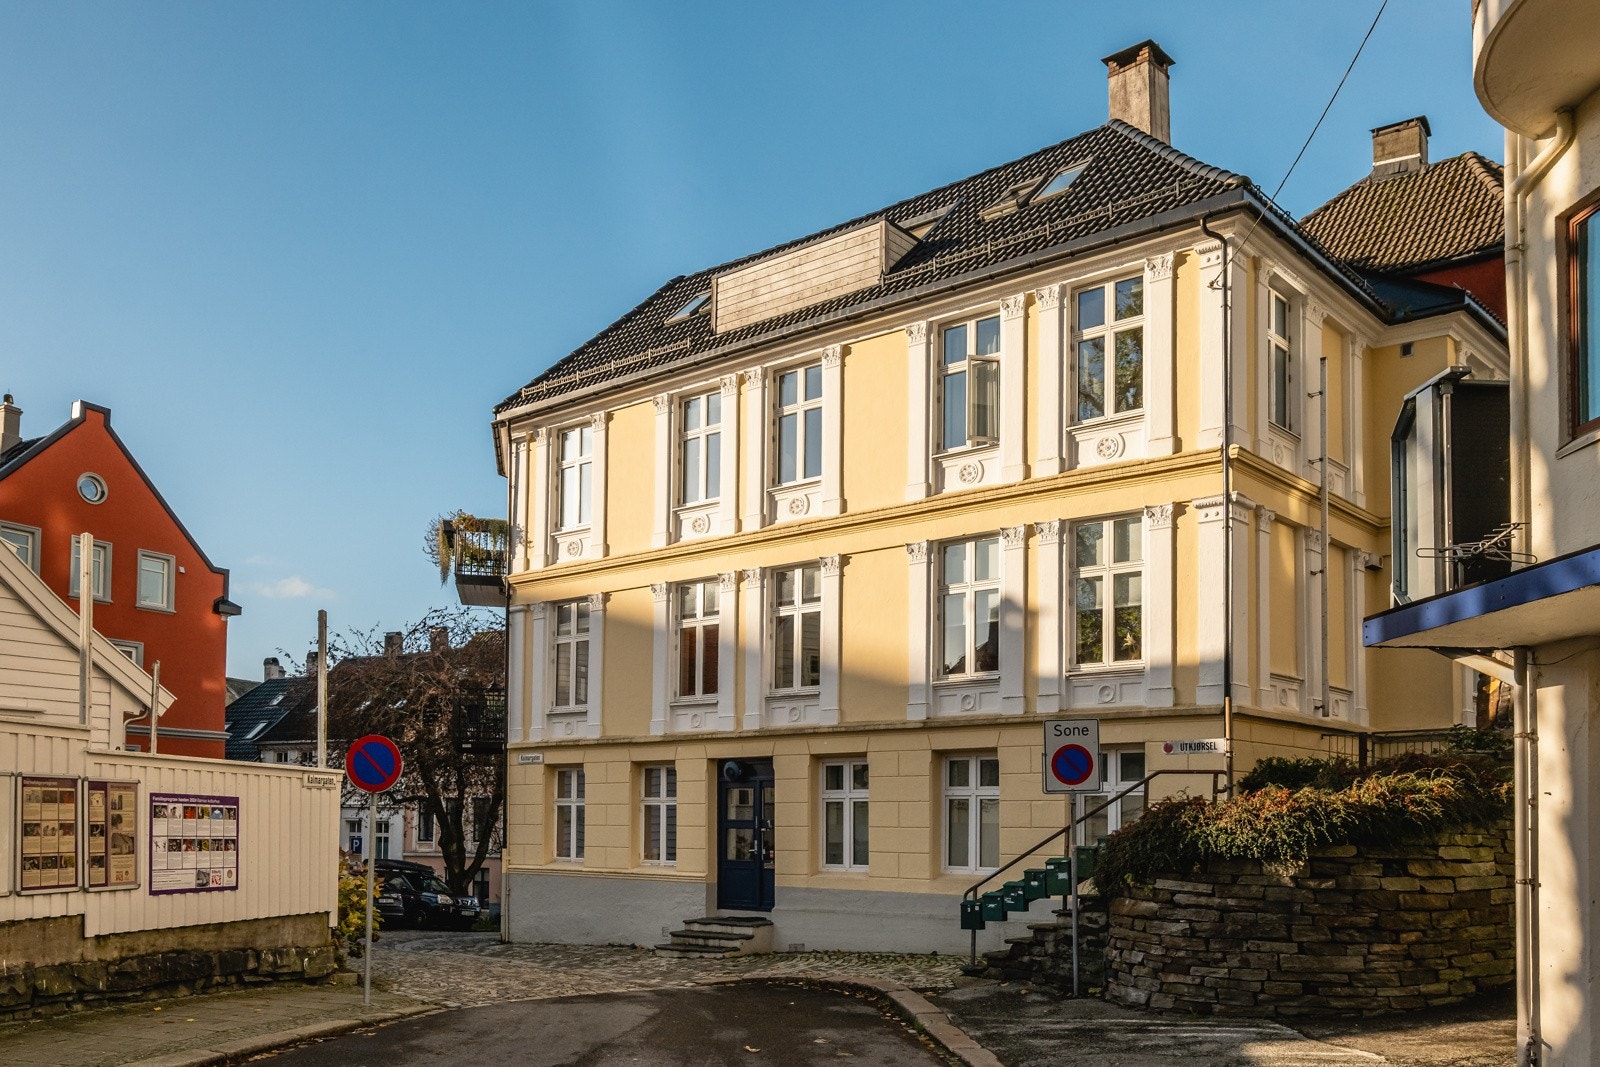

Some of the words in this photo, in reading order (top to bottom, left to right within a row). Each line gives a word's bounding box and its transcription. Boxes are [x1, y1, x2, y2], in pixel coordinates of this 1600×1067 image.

[1053, 724, 1090, 737] Sone
[1179, 741, 1218, 752] UTKJØRSEL
[353, 839, 360, 852] P
